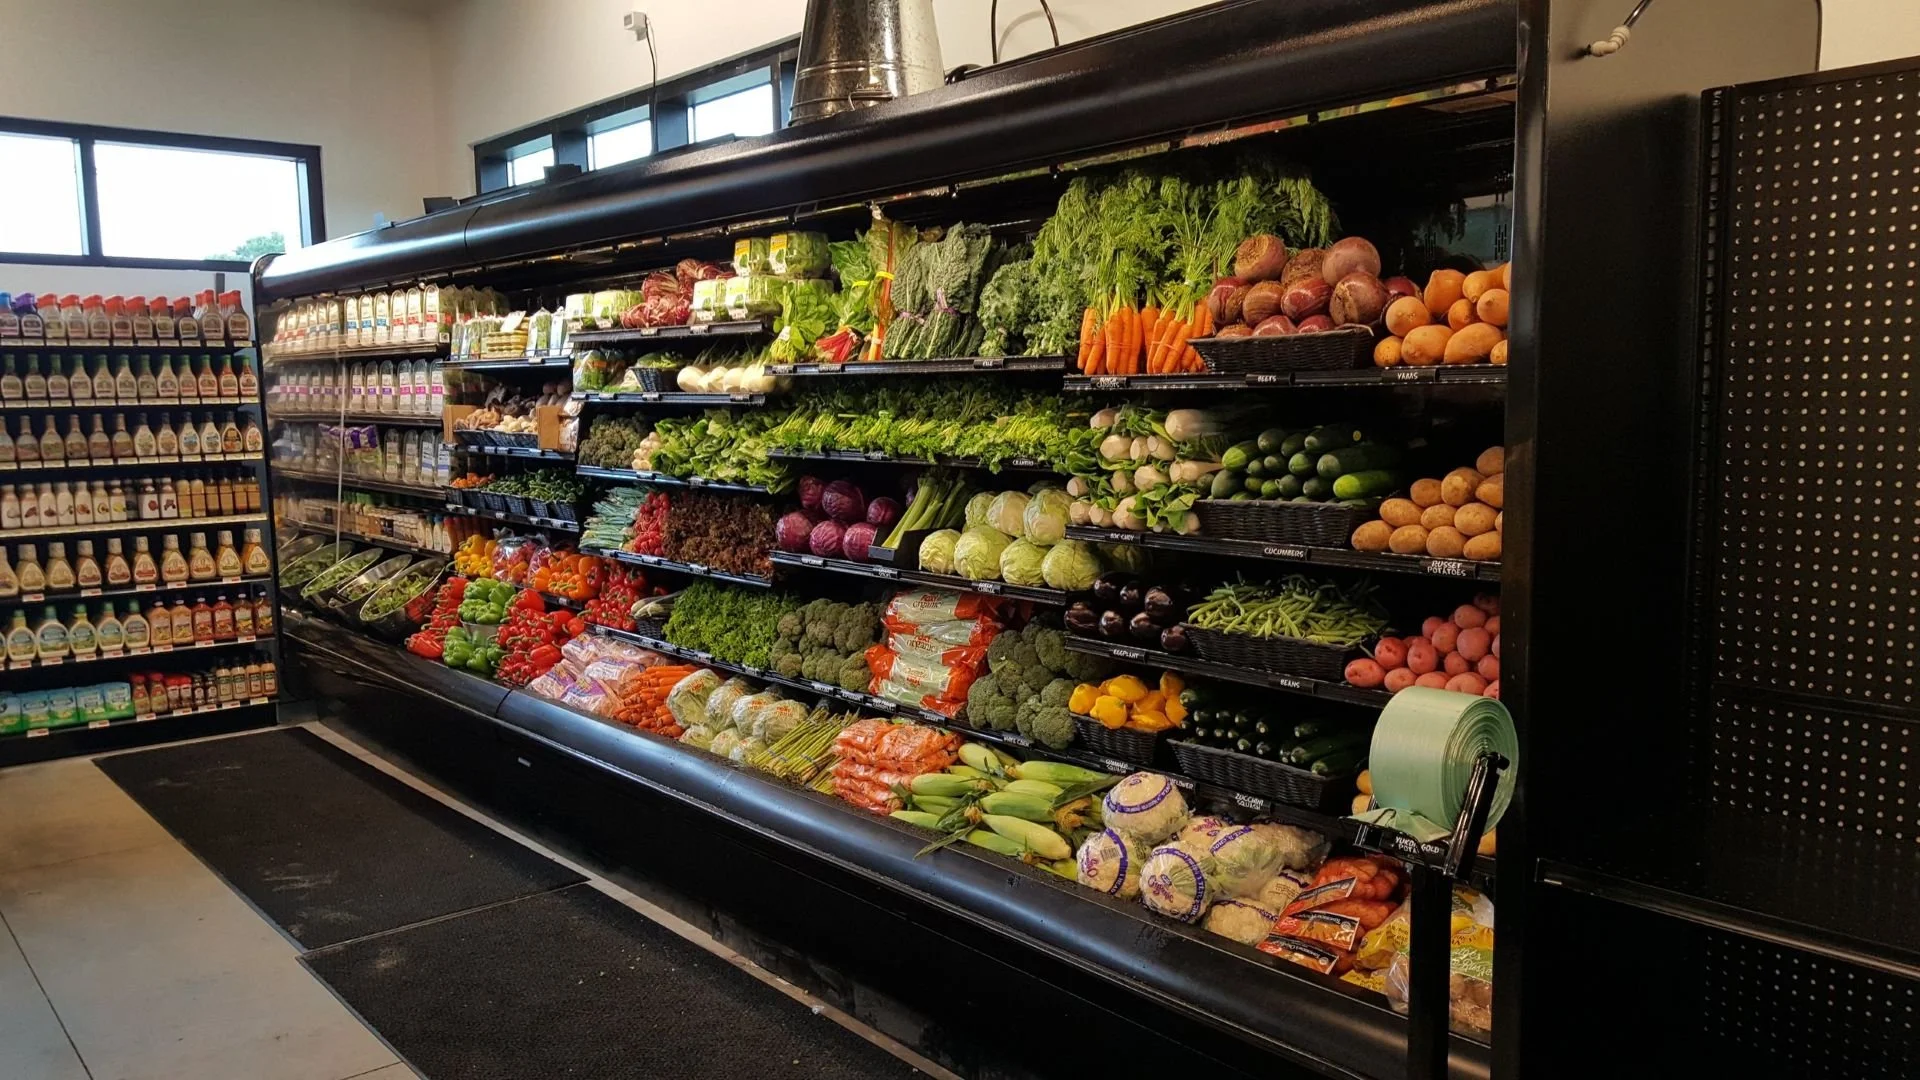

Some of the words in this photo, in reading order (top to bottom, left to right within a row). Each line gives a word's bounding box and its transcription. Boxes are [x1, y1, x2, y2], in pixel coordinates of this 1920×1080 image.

[1397, 372, 1418, 380] YAMS
[1263, 547, 1304, 558] CUCUMBERS
[1431, 559, 1463, 569] RUSSET
[1427, 566, 1467, 577] POTATOES
[1280, 679, 1300, 689] BEANS
[1420, 843, 1440, 854] GOLD
